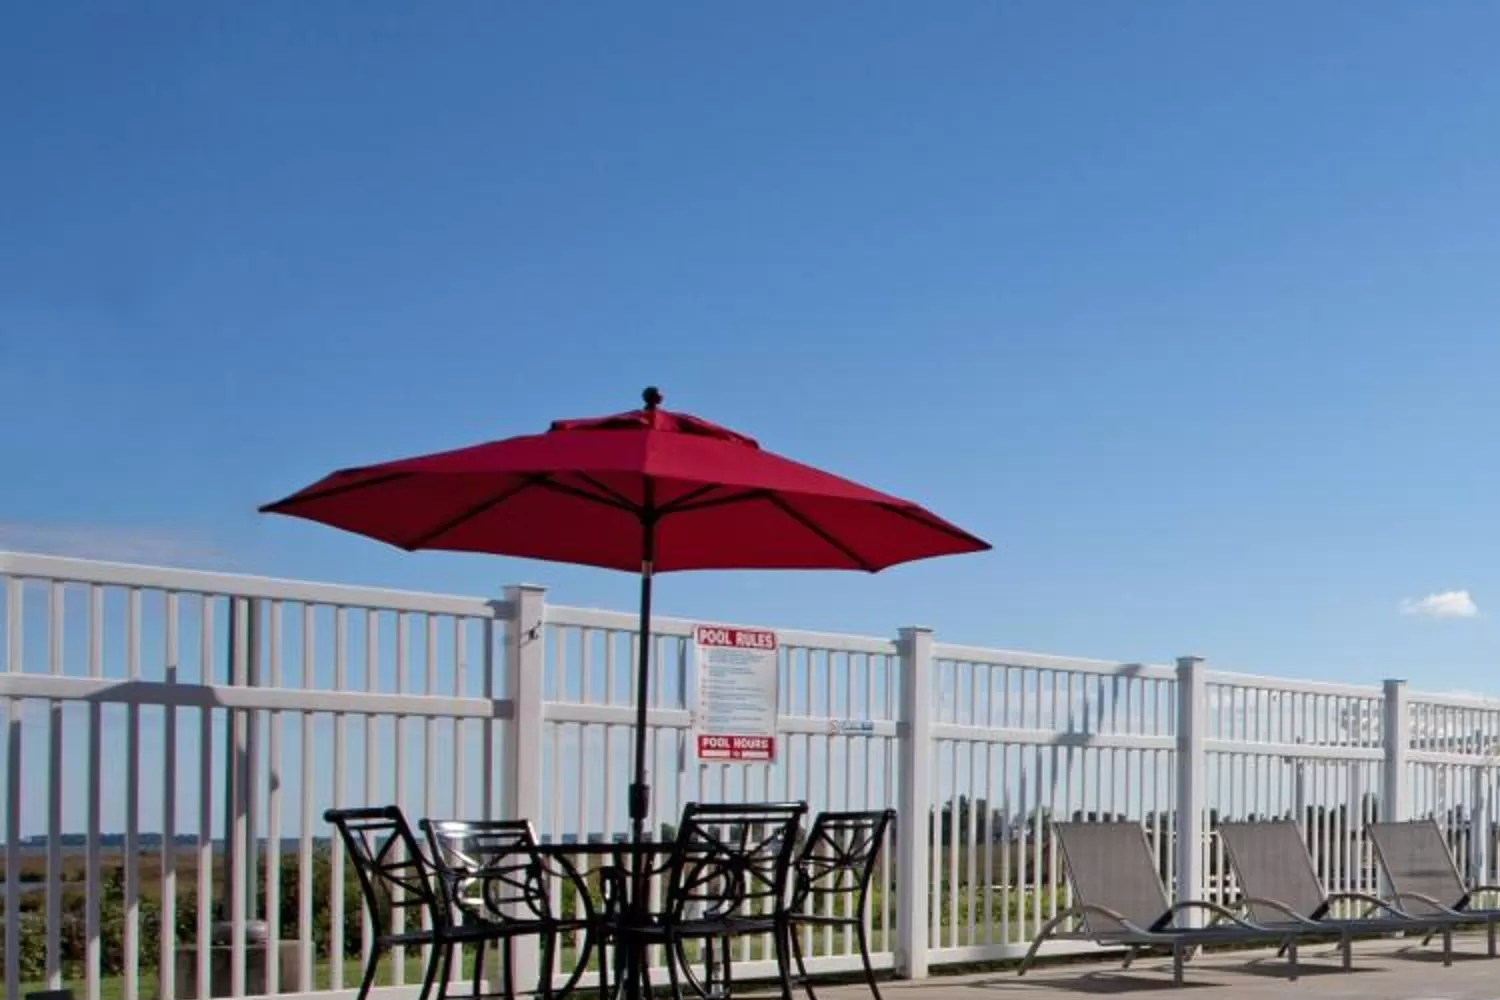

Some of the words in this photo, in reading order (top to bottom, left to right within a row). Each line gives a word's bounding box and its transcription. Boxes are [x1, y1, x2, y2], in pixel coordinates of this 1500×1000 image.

[700, 628, 732, 645] POOL
[736, 631, 772, 649] RULES
[703, 737, 731, 749] POOL
[733, 737, 769, 749] HOURS
